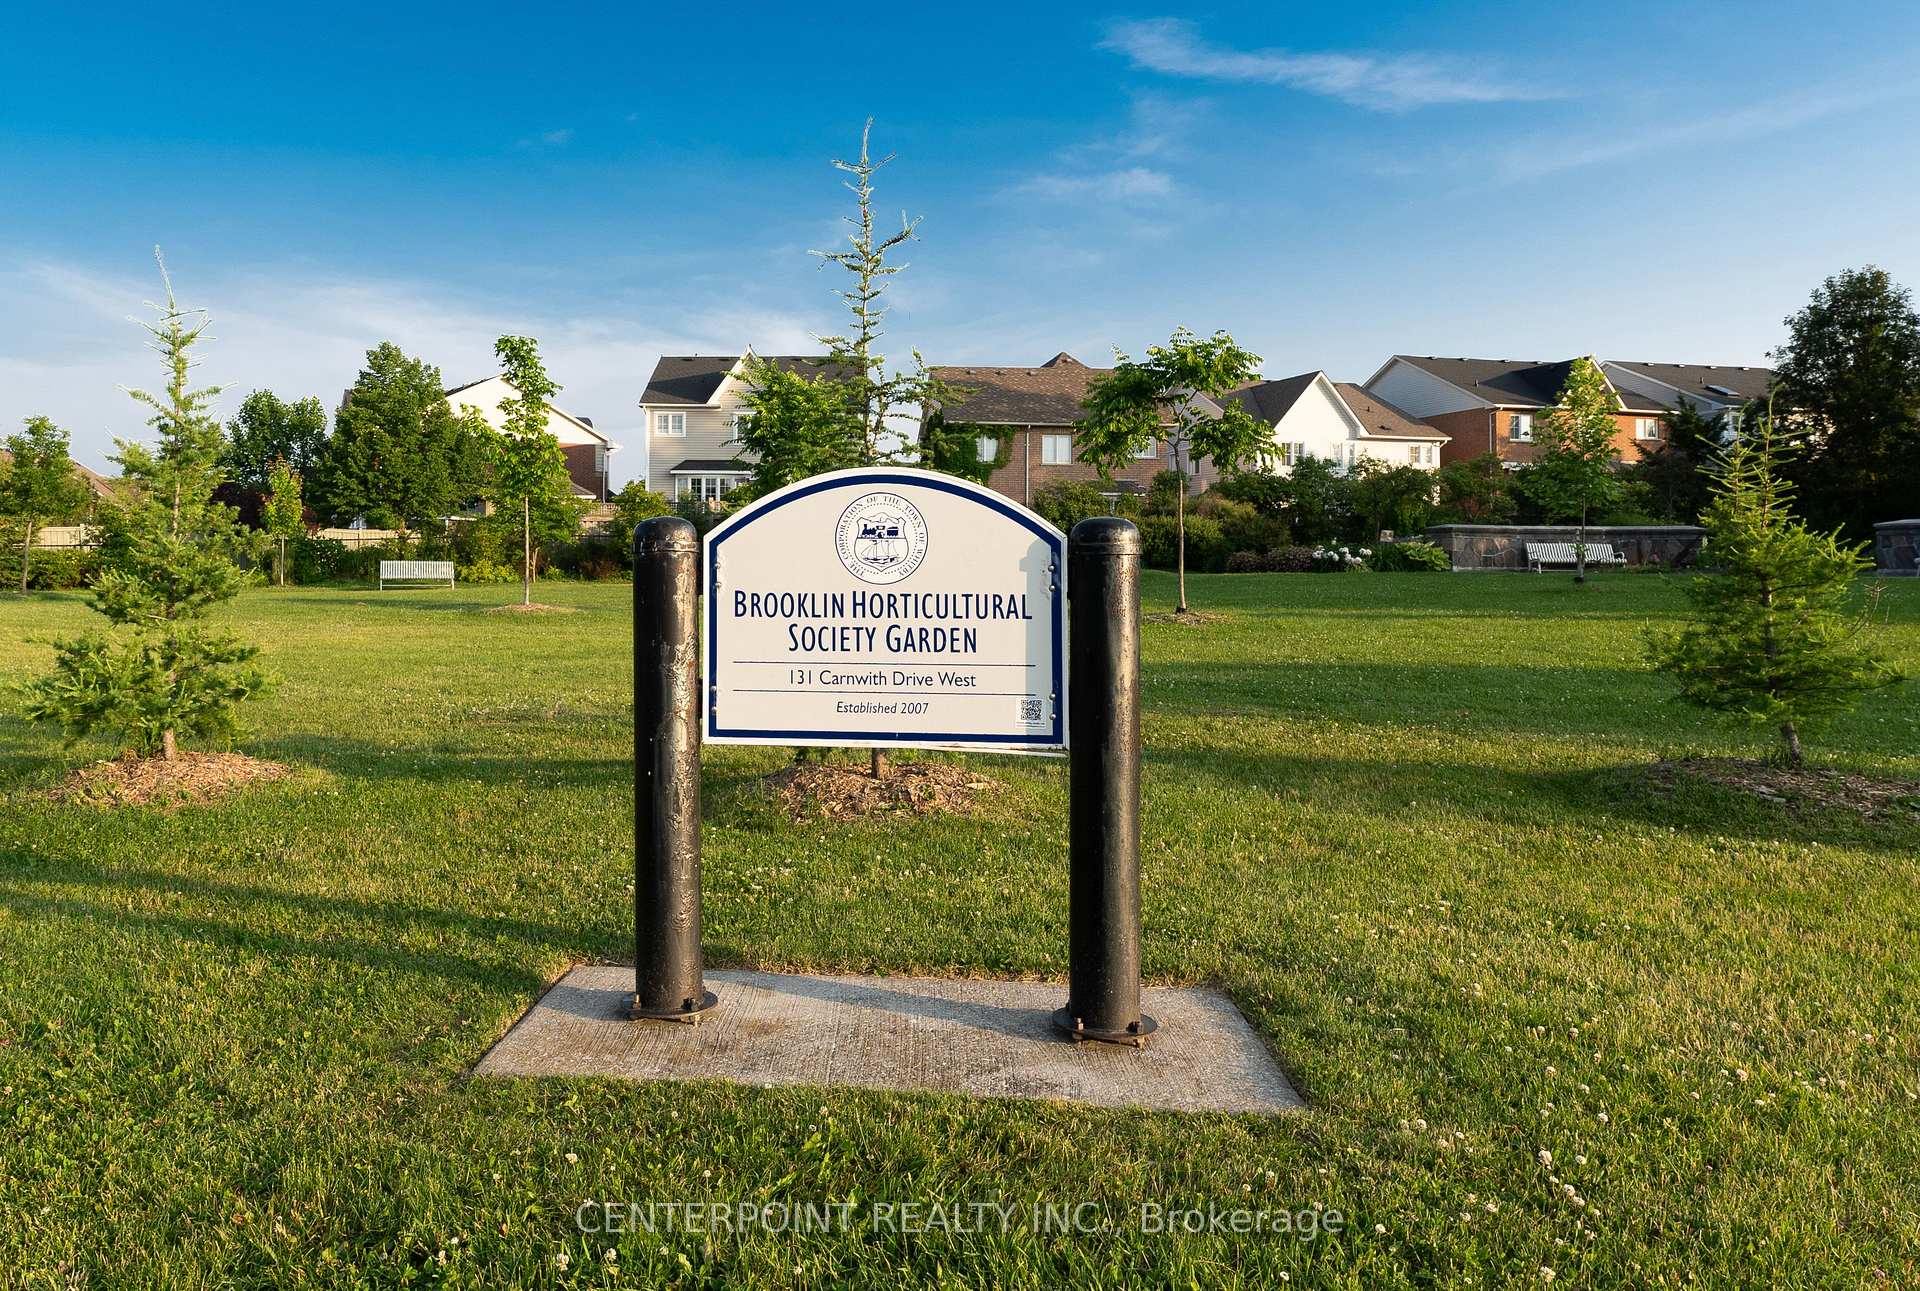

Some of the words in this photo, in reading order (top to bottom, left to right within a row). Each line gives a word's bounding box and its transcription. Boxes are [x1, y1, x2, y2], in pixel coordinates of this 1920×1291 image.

[883, 496, 901, 505] THE
[905, 505, 923, 529] TOWN
[838, 503, 863, 560] CORPORATION
[919, 532, 925, 544] OF
[849, 560, 864, 577] THE
[898, 548, 923, 577] WHITBY
[790, 670, 812, 685] 131
[820, 670, 886, 685] Carnwith
[893, 671, 933, 686] Drive
[938, 672, 976, 686] West
[837, 701, 897, 713] Established
[901, 703, 928, 714] 2007
